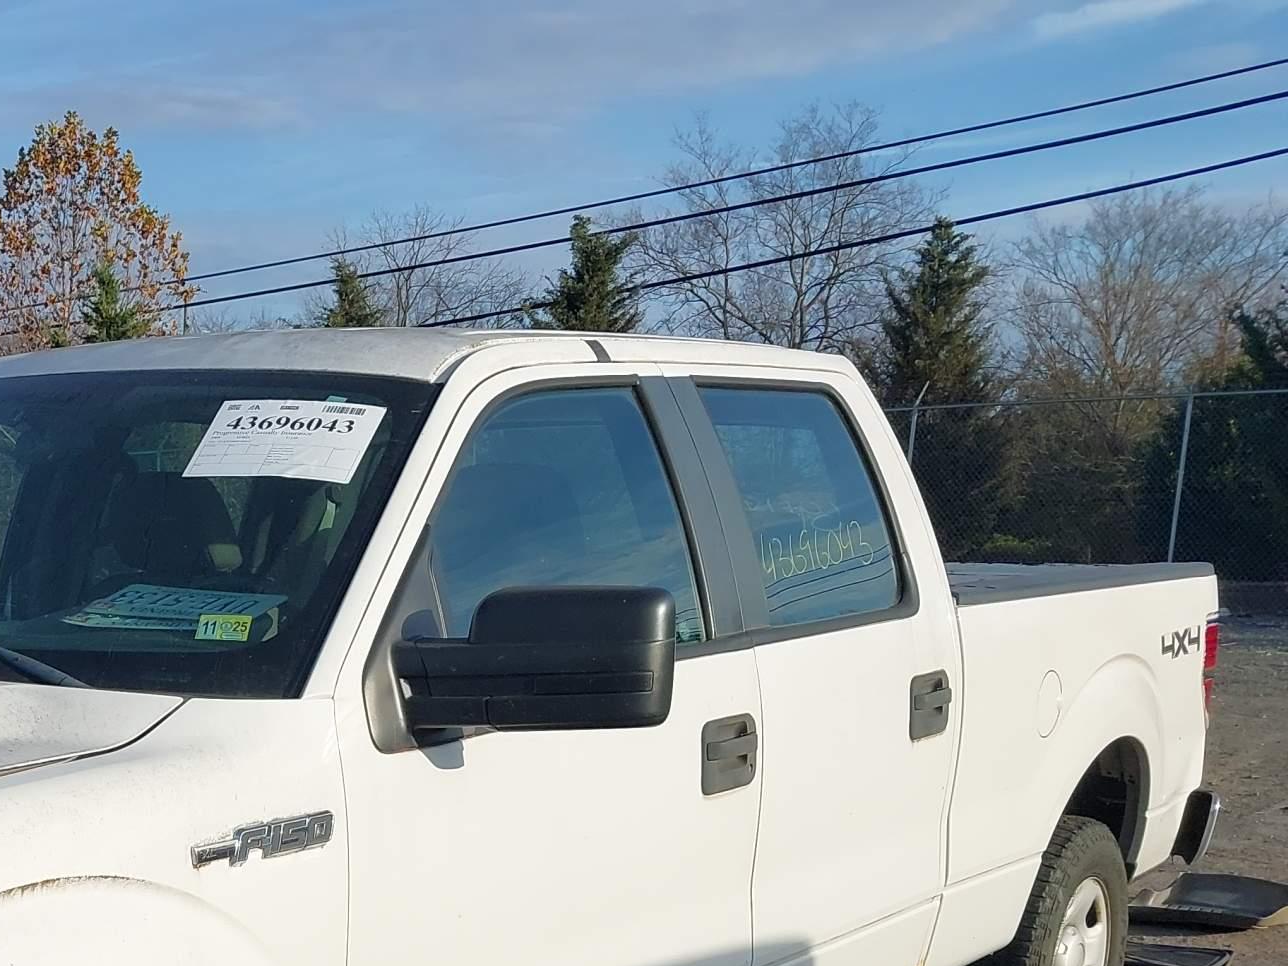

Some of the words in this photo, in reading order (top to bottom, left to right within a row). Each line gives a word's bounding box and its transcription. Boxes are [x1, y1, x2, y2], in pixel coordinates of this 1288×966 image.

[226, 414, 355, 434] 43696043
[760, 520, 874, 580] 43696043
[202, 620, 217, 635] 11
[232, 621, 248, 632] 25
